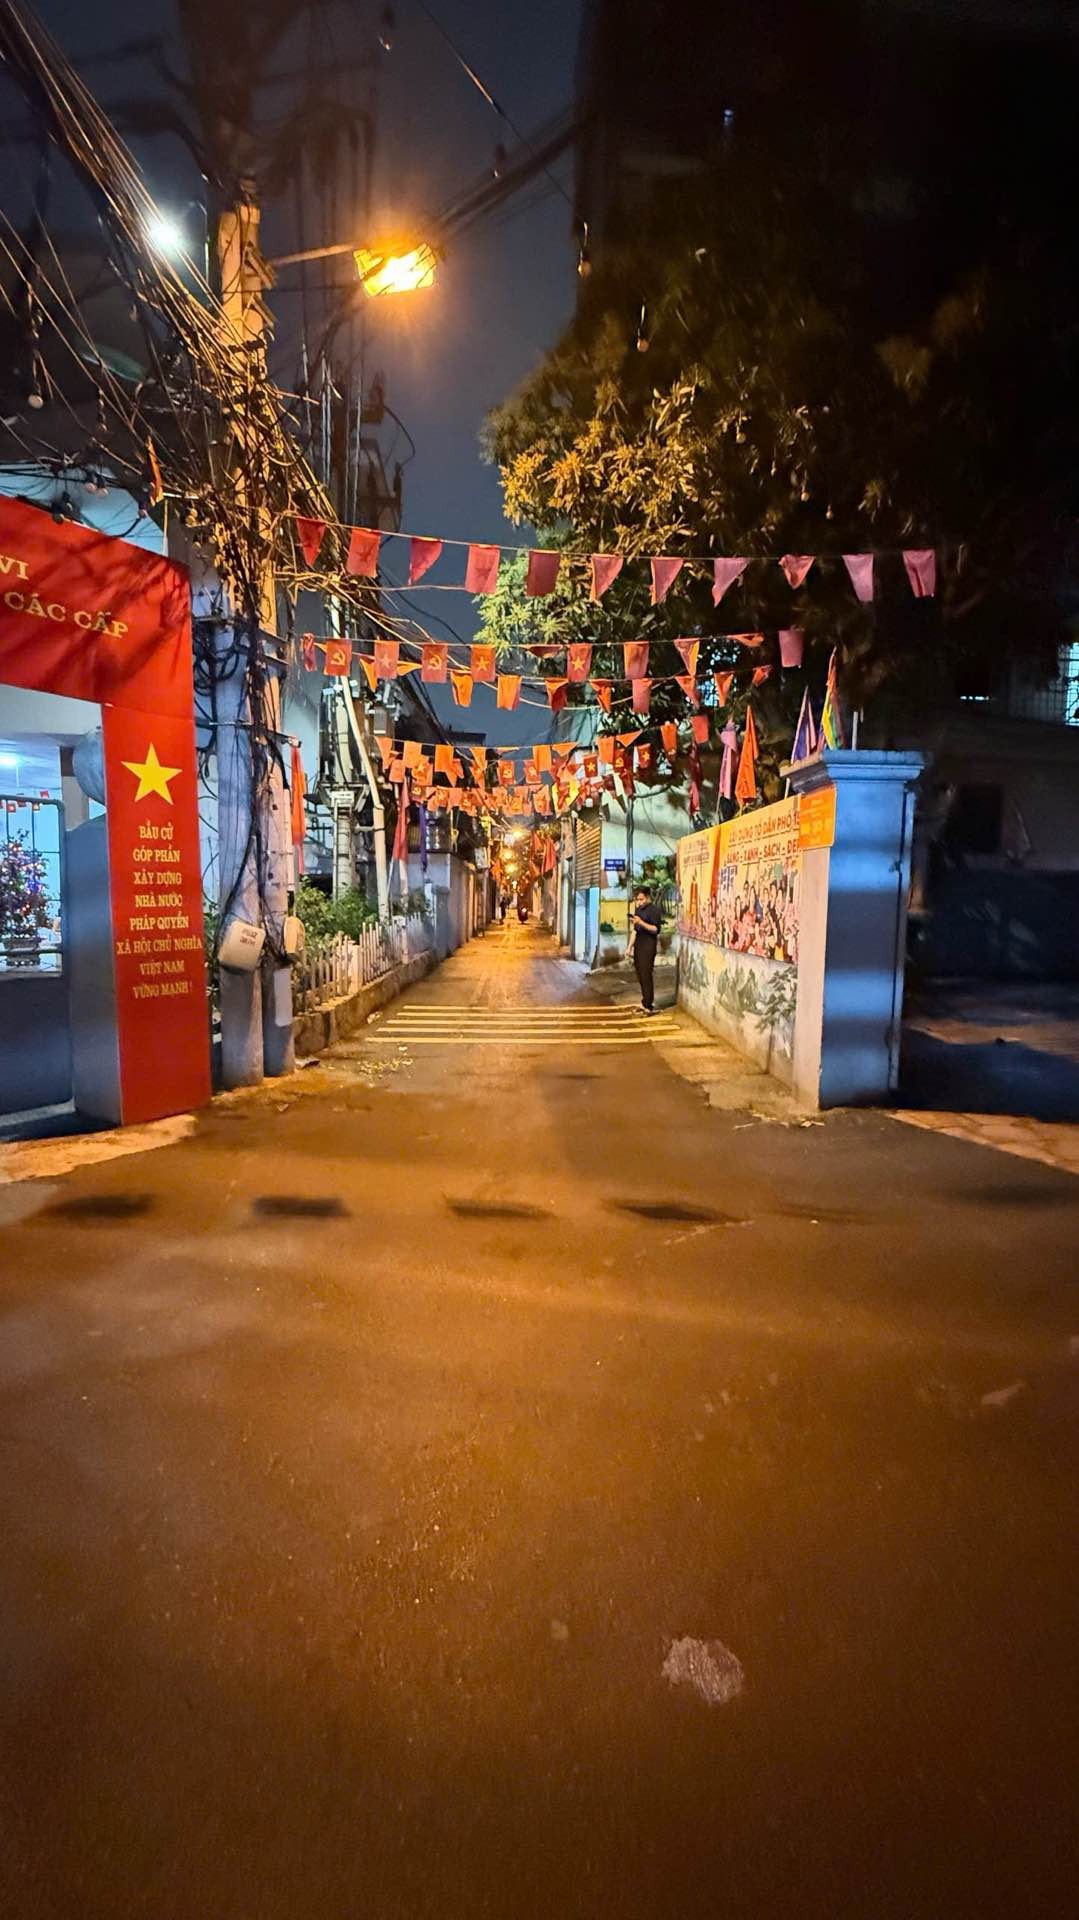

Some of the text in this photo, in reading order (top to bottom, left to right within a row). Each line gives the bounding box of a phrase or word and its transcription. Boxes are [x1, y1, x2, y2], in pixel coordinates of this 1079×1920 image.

[4, 591, 128, 639] CÁC CẤP
[161, 821, 174, 840] CỬ
[133, 843, 180, 863] GÓP PHẦN
[133, 868, 182, 888] XÂY DỰNG
[135, 891, 183, 908] NHÀ NƯỚC
[129, 910, 189, 931] PHÁP QUYỀN
[133, 936, 151, 955] HỘI
[153, 934, 172, 952] CHỦ
[140, 959, 185, 976] VIỆT NAM
